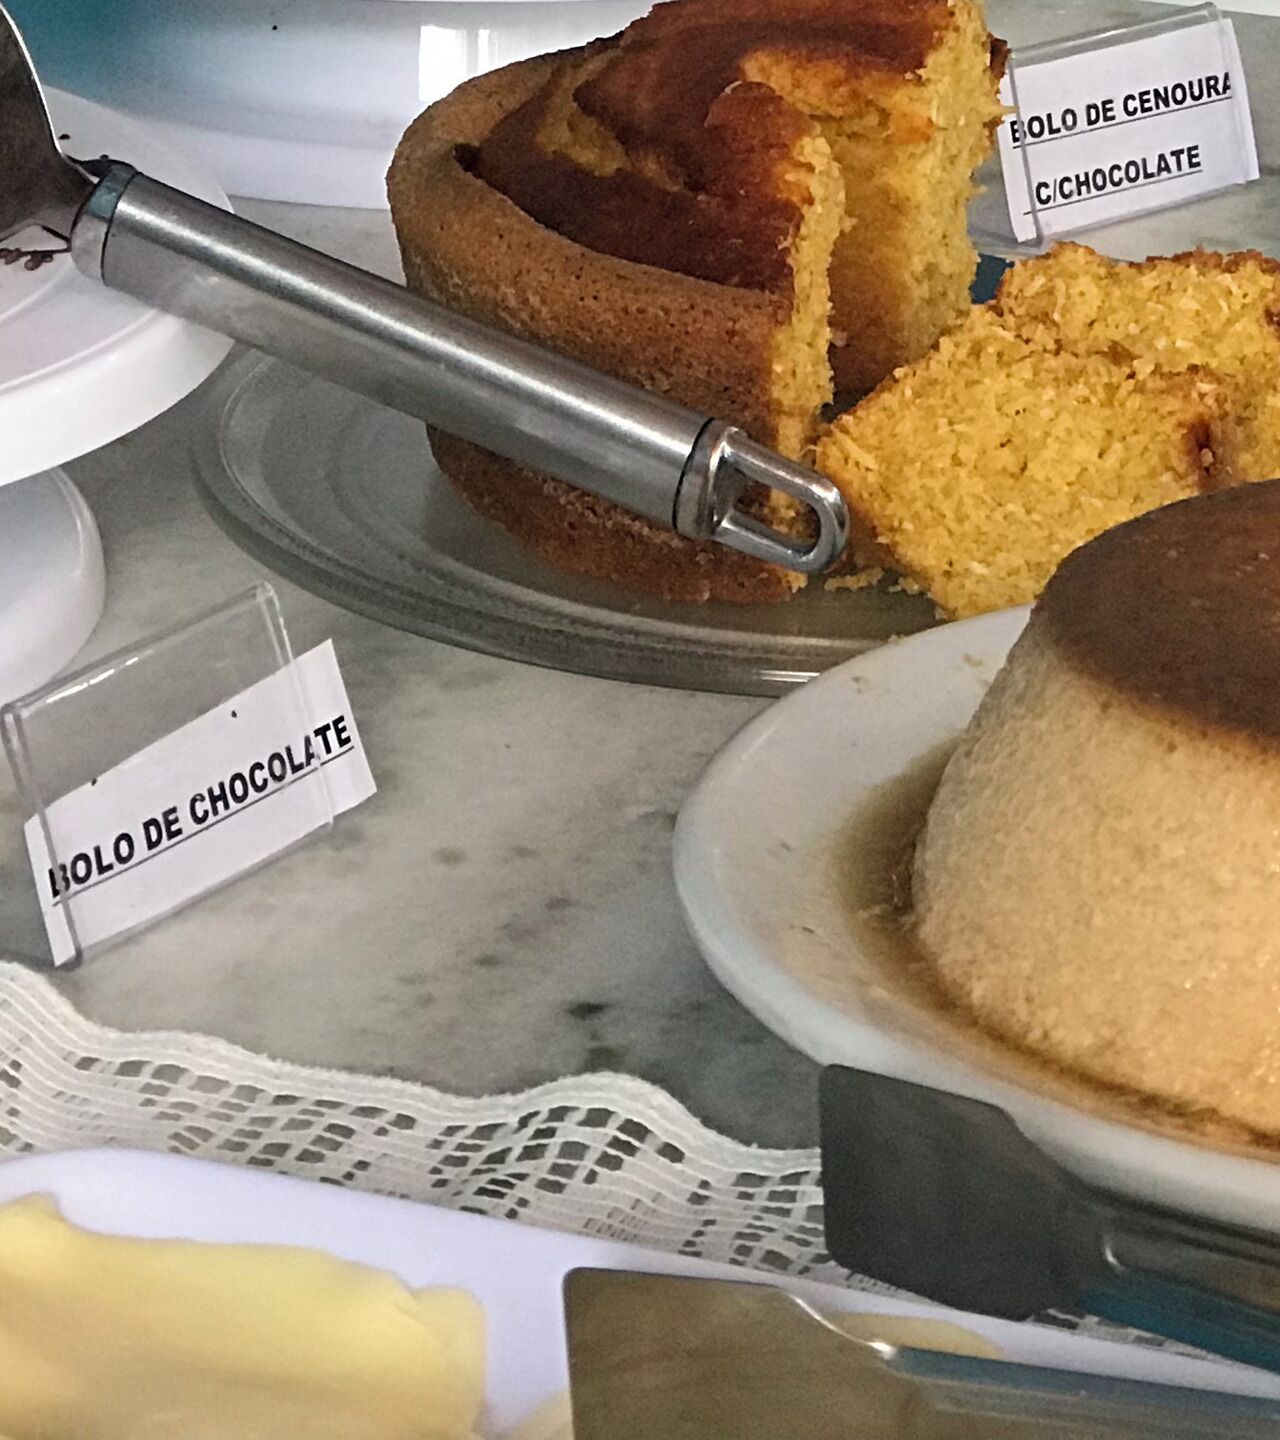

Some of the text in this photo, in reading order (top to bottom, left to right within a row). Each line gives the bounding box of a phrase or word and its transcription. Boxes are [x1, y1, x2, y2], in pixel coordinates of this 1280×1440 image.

[1009, 71, 1233, 144] BOLO DE CENOURA
[1035, 144, 1202, 205] C/CHOCOLATE
[47, 714, 353, 900] BOLO DE CHOCOLATE
